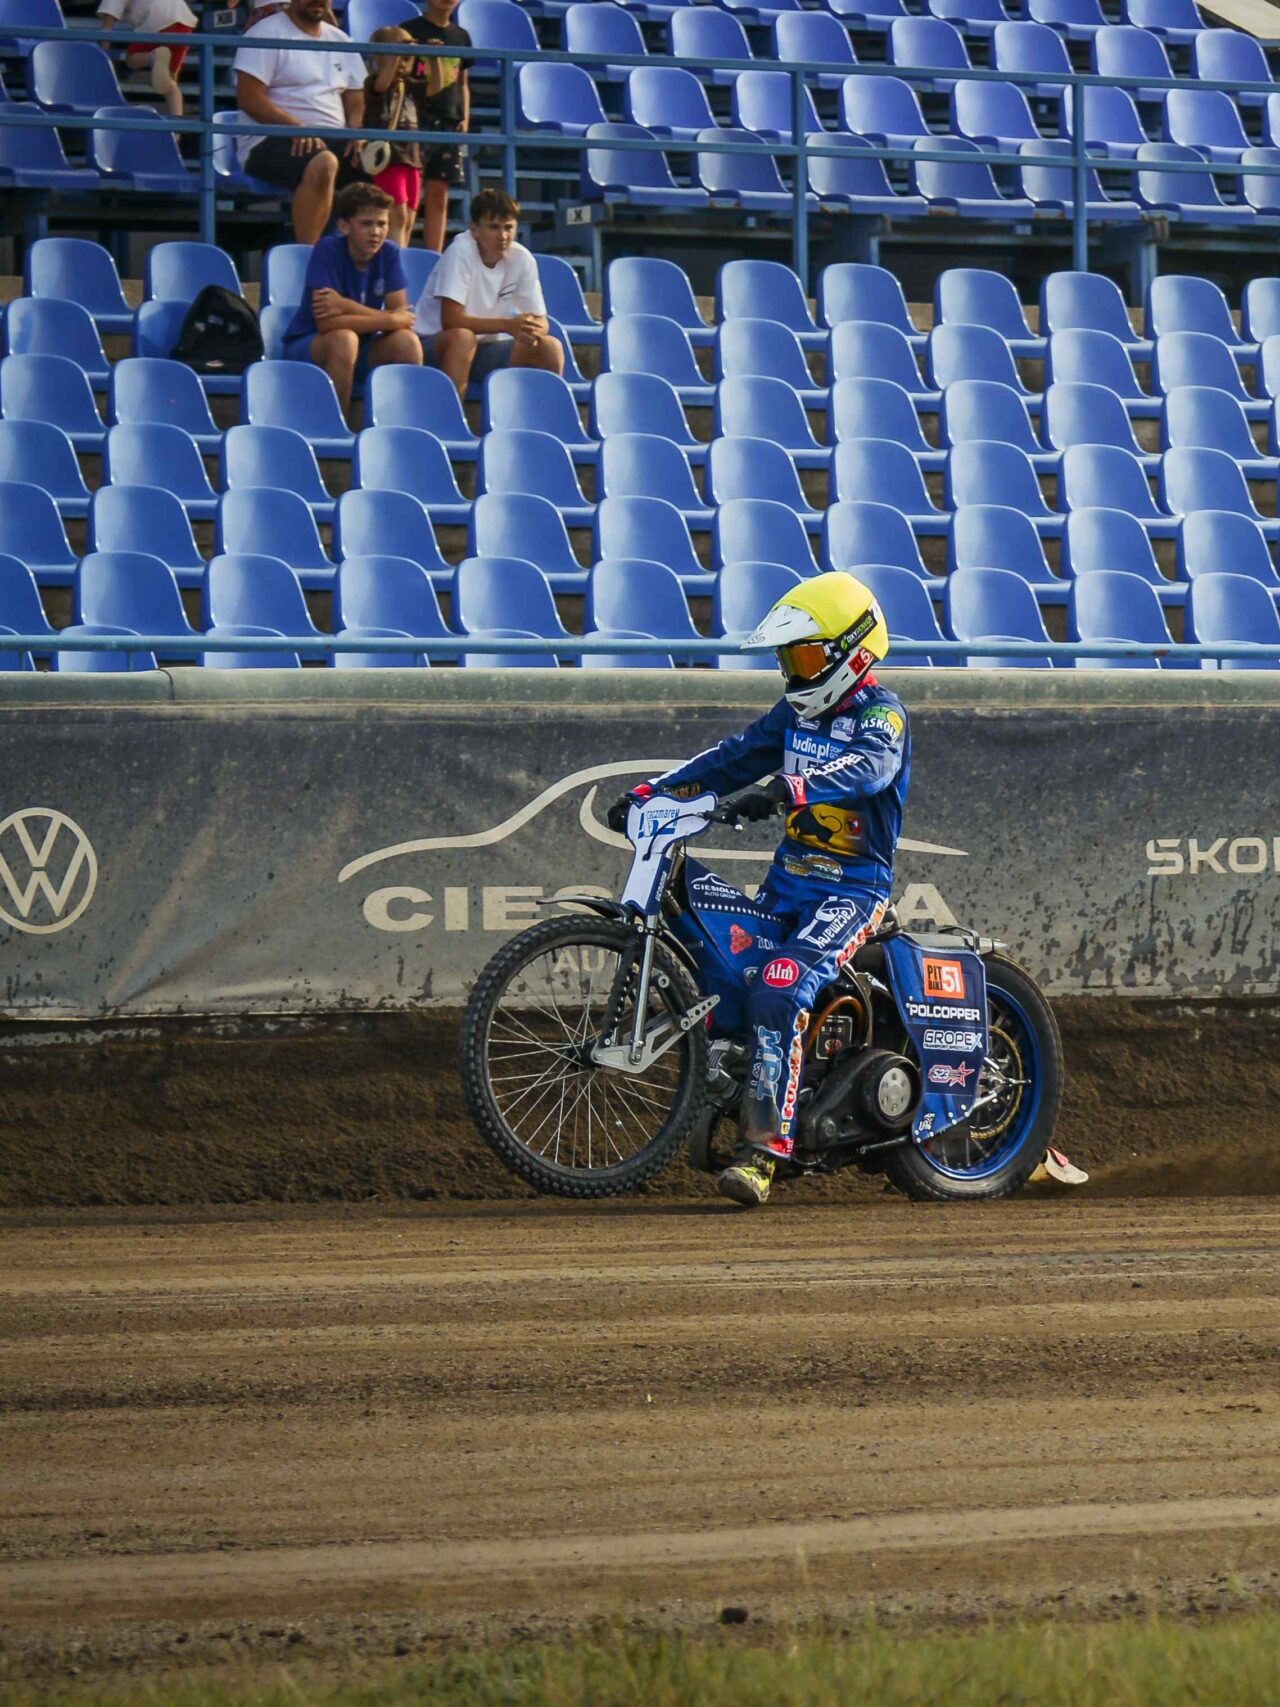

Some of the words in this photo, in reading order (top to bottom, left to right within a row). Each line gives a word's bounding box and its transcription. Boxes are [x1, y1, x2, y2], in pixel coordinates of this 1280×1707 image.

[927, 964, 942, 980] PIT
[942, 966, 962, 992] 51
[928, 981, 943, 991] BIKE
[909, 1003, 980, 1022] POLCOPPER
[924, 1029, 983, 1049] GROPEX
